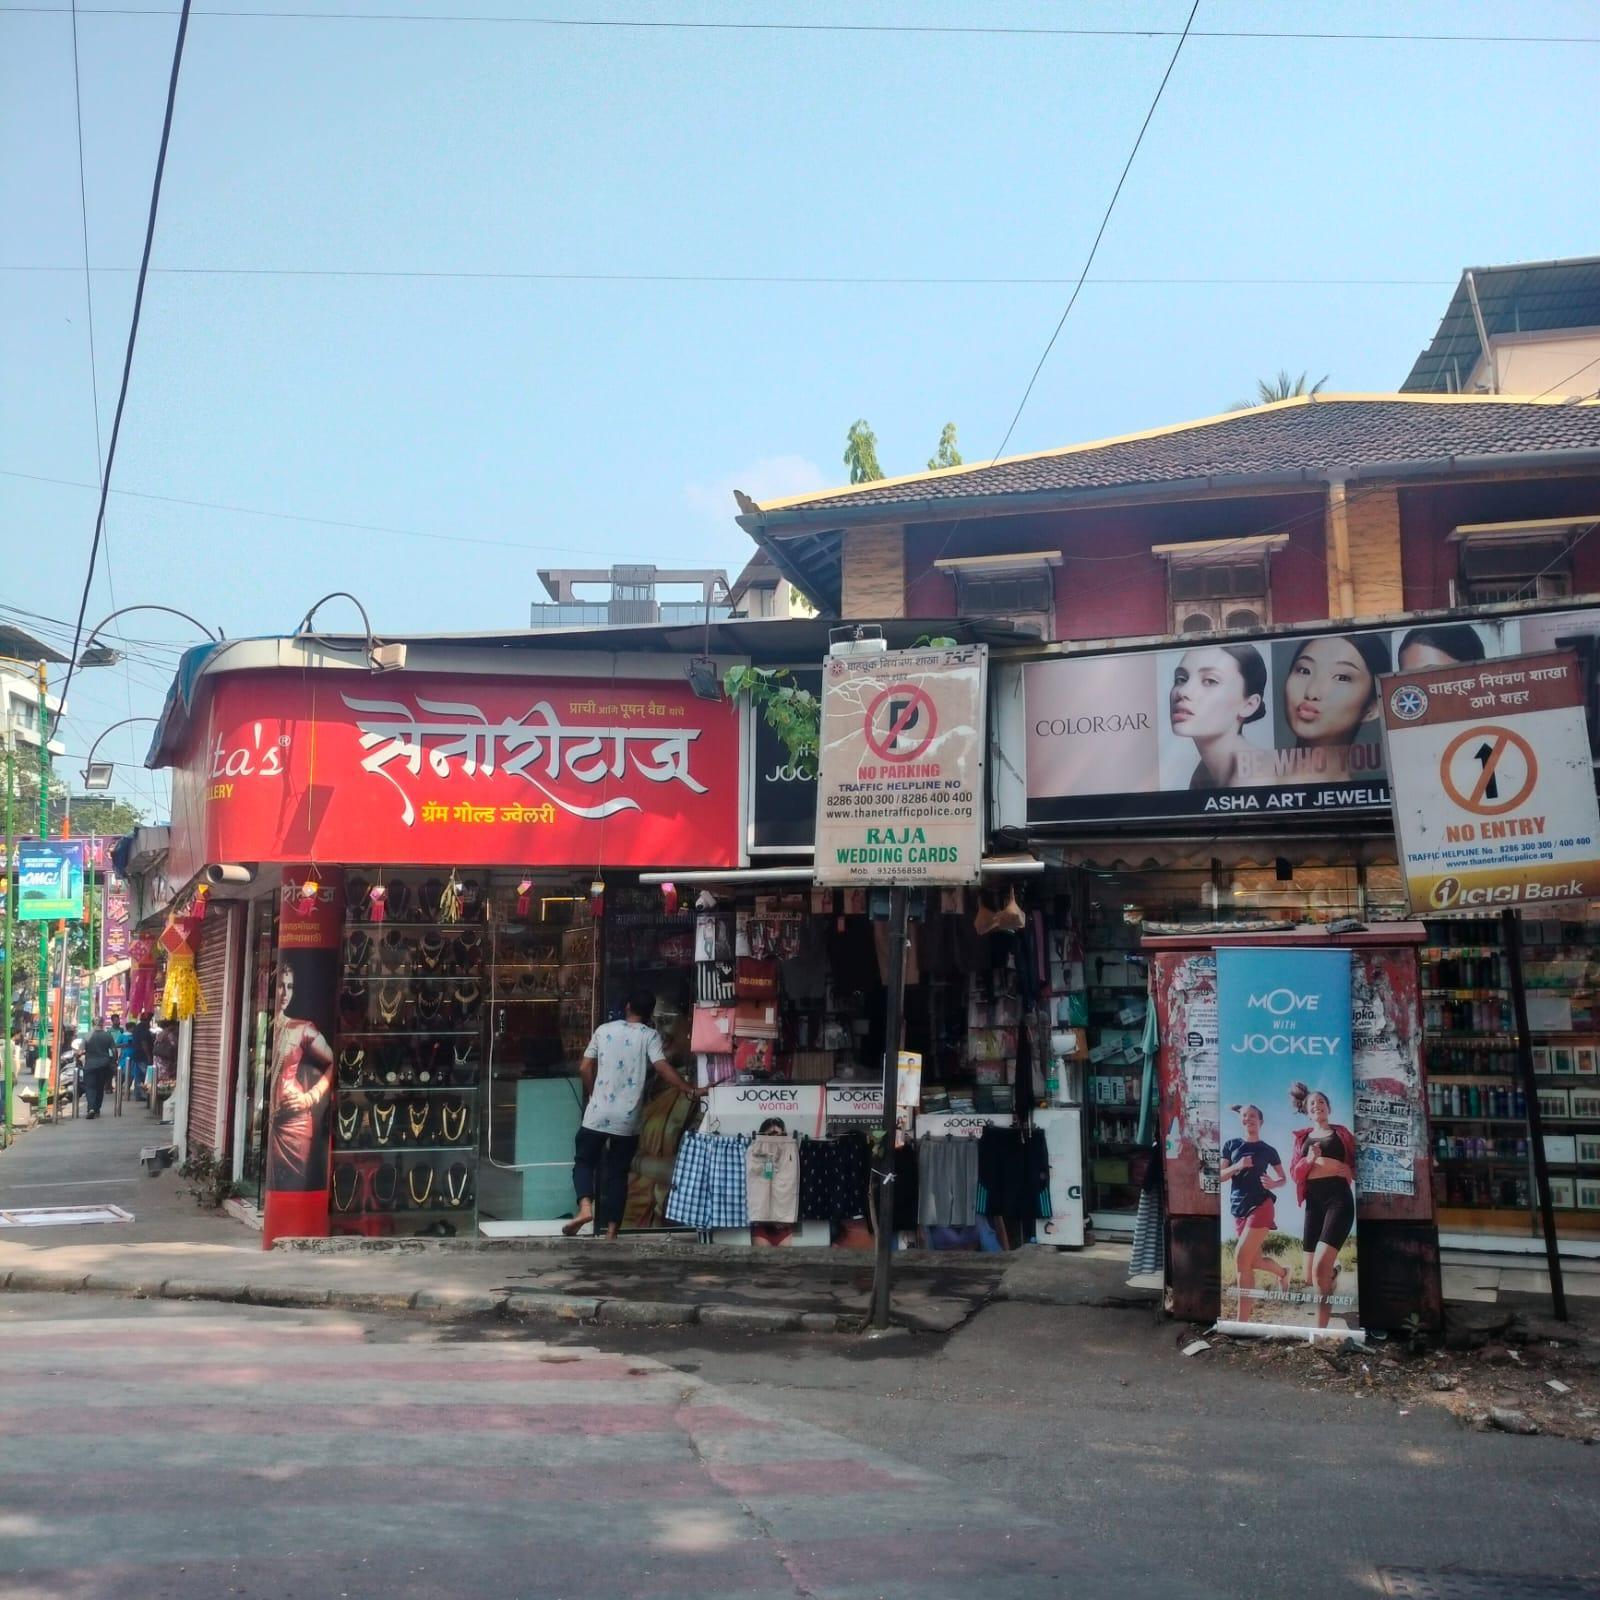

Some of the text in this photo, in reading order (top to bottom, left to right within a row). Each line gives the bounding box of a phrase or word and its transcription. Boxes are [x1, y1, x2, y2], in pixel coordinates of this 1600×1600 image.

[1429, 667, 1569, 696] वाहतूक नियंत्रण शाखा
[569, 700, 597, 715] प्राची
[1470, 690, 1530, 709] ठाणे शहर
[1035, 713, 1151, 737] COLORBAR
[1237, 743, 1382, 778] BE WHO YOU
[858, 763, 940, 780] NO PARKING
[838, 780, 961, 793] TRAFFIC HELPLINE NO
[826, 795, 851, 807] 8286
[854, 794, 873, 806] 300
[875, 793, 894, 805] 300
[901, 792, 928, 804] 8286
[930, 792, 951, 804] 400
[952, 791, 973, 803] 400
[1204, 795, 1260, 812] ASHA
[1266, 792, 1307, 809] ART
[421, 801, 556, 824] ग्रॅम गोल्ड ज्वेलरी
[826, 806, 973, 819] www.thanetrafficpolice.org
[866, 827, 927, 845] RAJA
[1446, 816, 1546, 843] NO ENTRY
[836, 846, 959, 864] WEDDING CARDS
[1407, 852, 1440, 863] TRAFFIC
[1442, 847, 1480, 859] HELPLINE
[1521, 840, 1536, 851] 300
[1538, 840, 1552, 850] 300
[1559, 838, 1574, 848] 400
[1576, 836, 1591, 846] 400
[1458, 884, 1520, 906] ICICI
[1525, 879, 1584, 900] Bank
[1248, 988, 1320, 1015] MOVE
[1273, 1020, 1297, 1031] WITH
[1231, 1033, 1341, 1056] JOCKEY
[736, 1088, 799, 1102] JOCKEY
[758, 1101, 798, 1112] woman
[1263, 1289, 1311, 1303] ACTIVEWEAR
[1313, 1294, 1323, 1303] BY
[1325, 1294, 1354, 1306] JOCKEY
